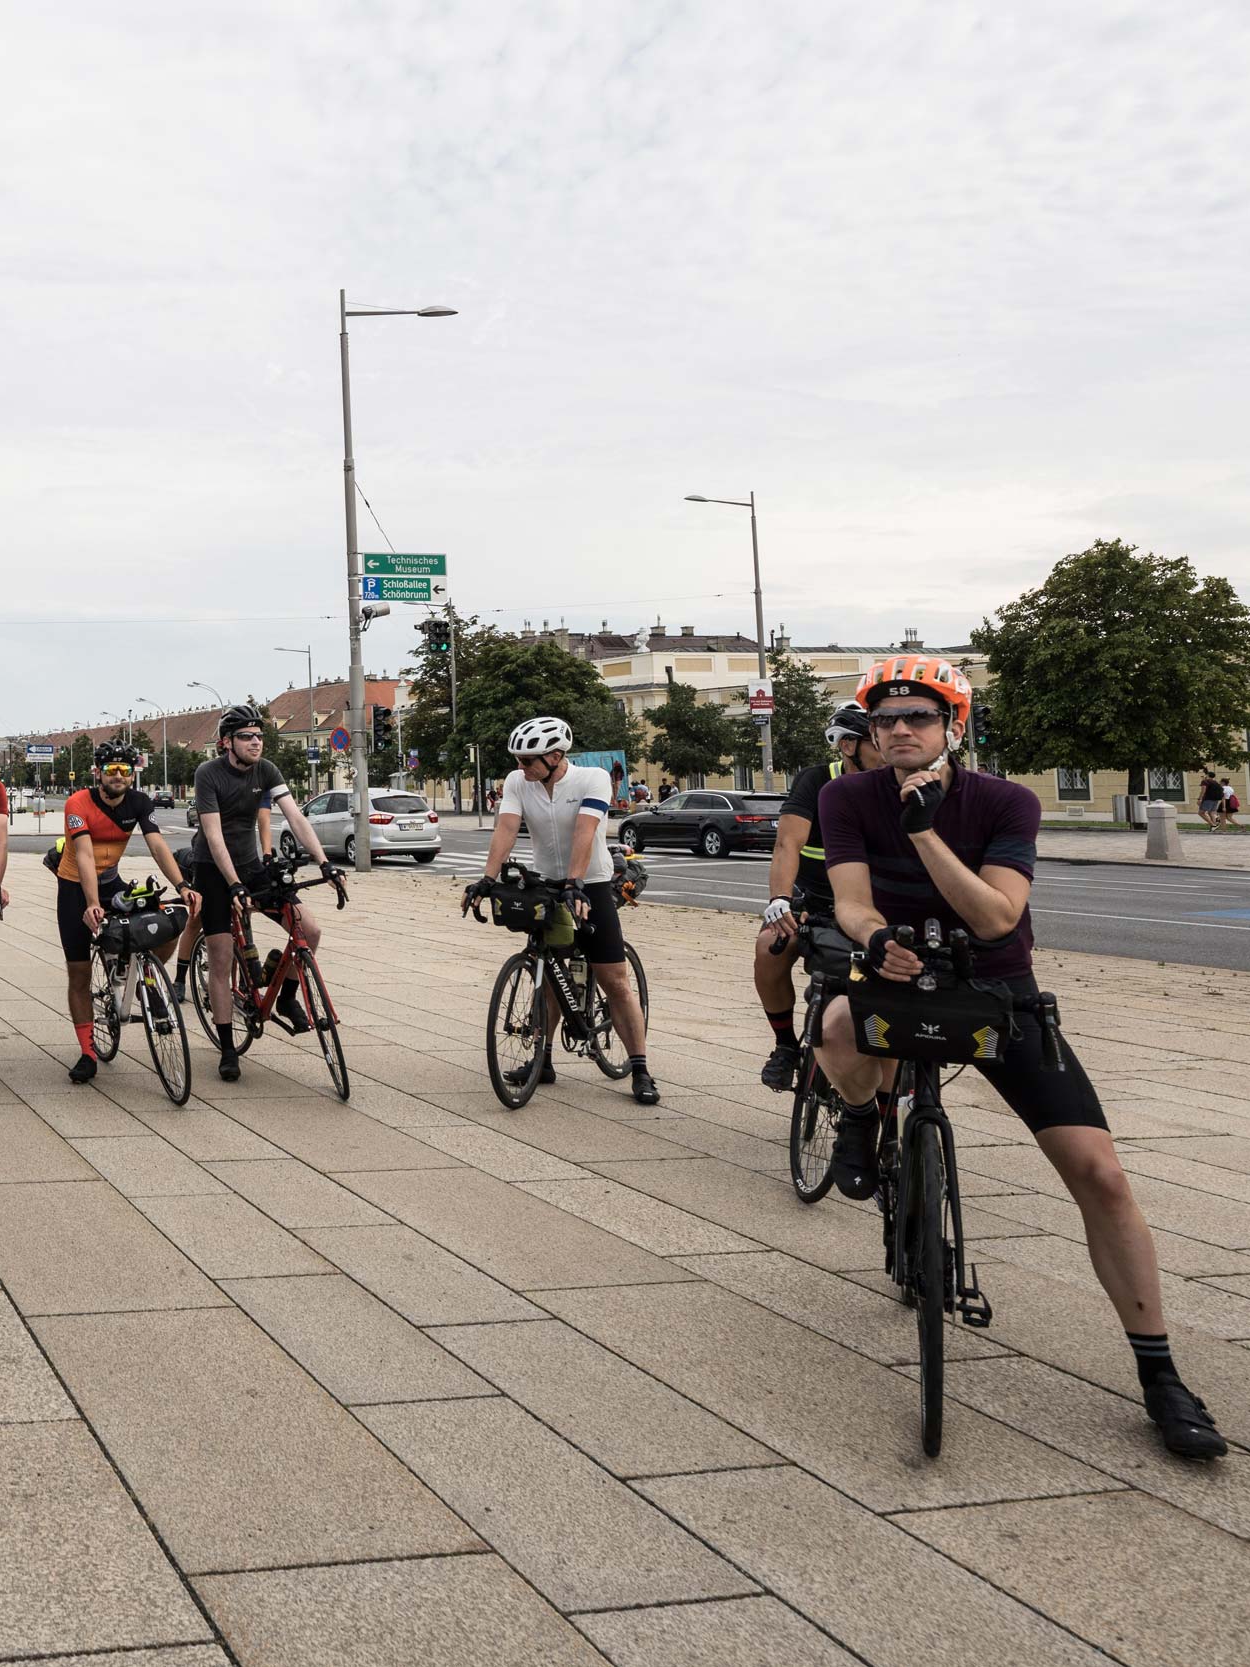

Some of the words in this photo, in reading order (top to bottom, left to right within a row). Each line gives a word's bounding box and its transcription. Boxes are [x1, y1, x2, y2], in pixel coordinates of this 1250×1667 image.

[387, 556, 439, 565] Technisches
[395, 565, 431, 573] Museum
[382, 580, 428, 589] Schloßallee
[382, 589, 429, 599] Schönbrunn
[889, 686, 911, 696] 58
